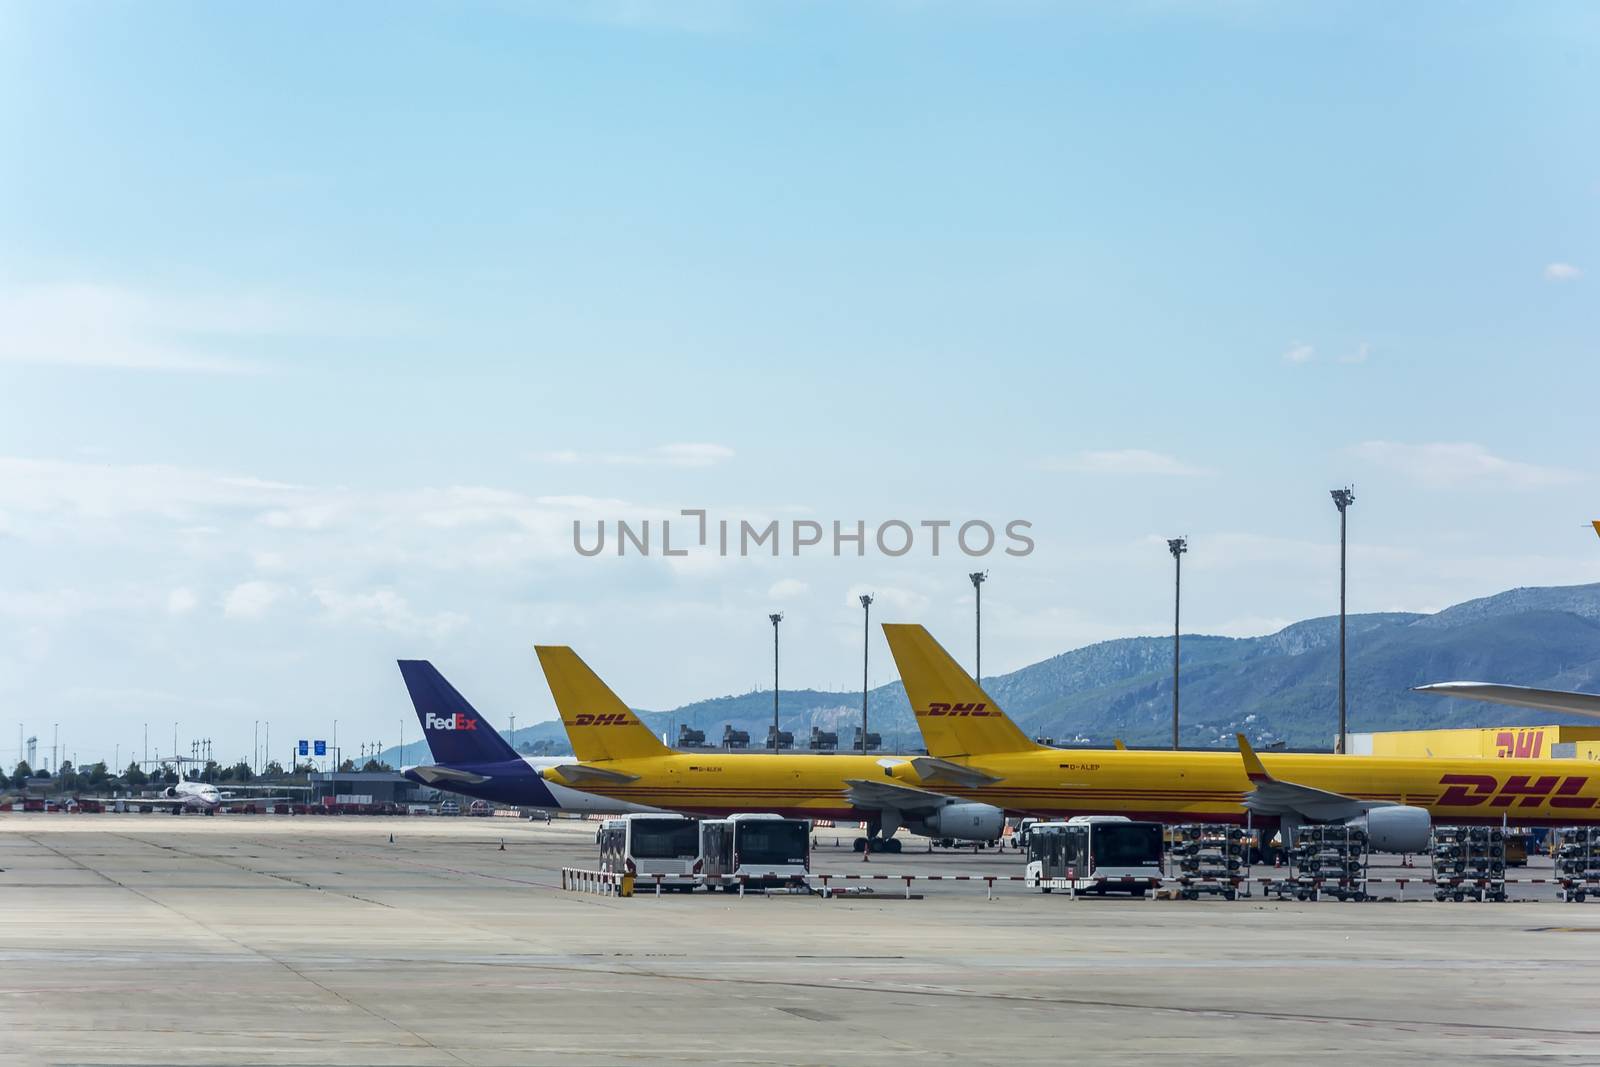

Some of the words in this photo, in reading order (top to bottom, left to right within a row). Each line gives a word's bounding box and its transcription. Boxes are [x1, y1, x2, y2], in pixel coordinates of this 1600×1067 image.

[928, 702, 991, 716] DHL
[425, 712, 478, 730] FedEx
[576, 714, 629, 726] DHL
[1436, 774, 1599, 808] DHL
